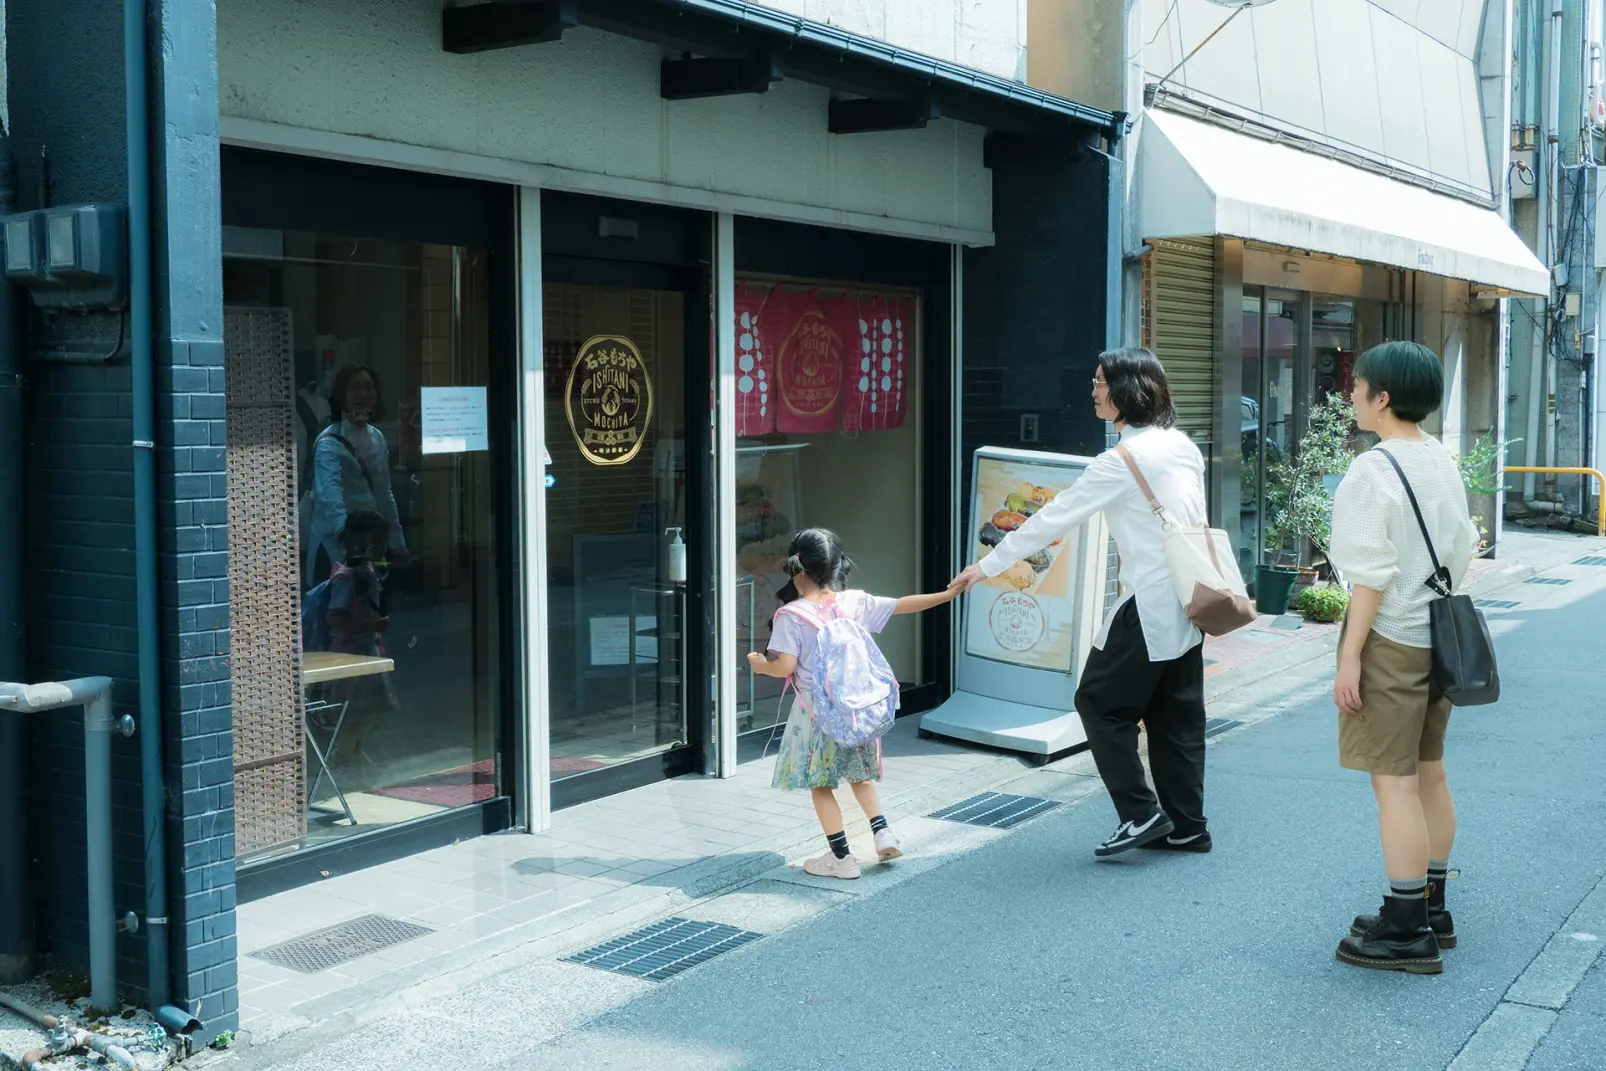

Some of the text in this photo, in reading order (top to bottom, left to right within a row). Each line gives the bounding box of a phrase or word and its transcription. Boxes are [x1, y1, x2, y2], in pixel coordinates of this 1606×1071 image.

[585, 347, 637, 372] 石谷もちや
[593, 364, 628, 393] ISHITANI
[594, 412, 629, 429] MOCHIYA
